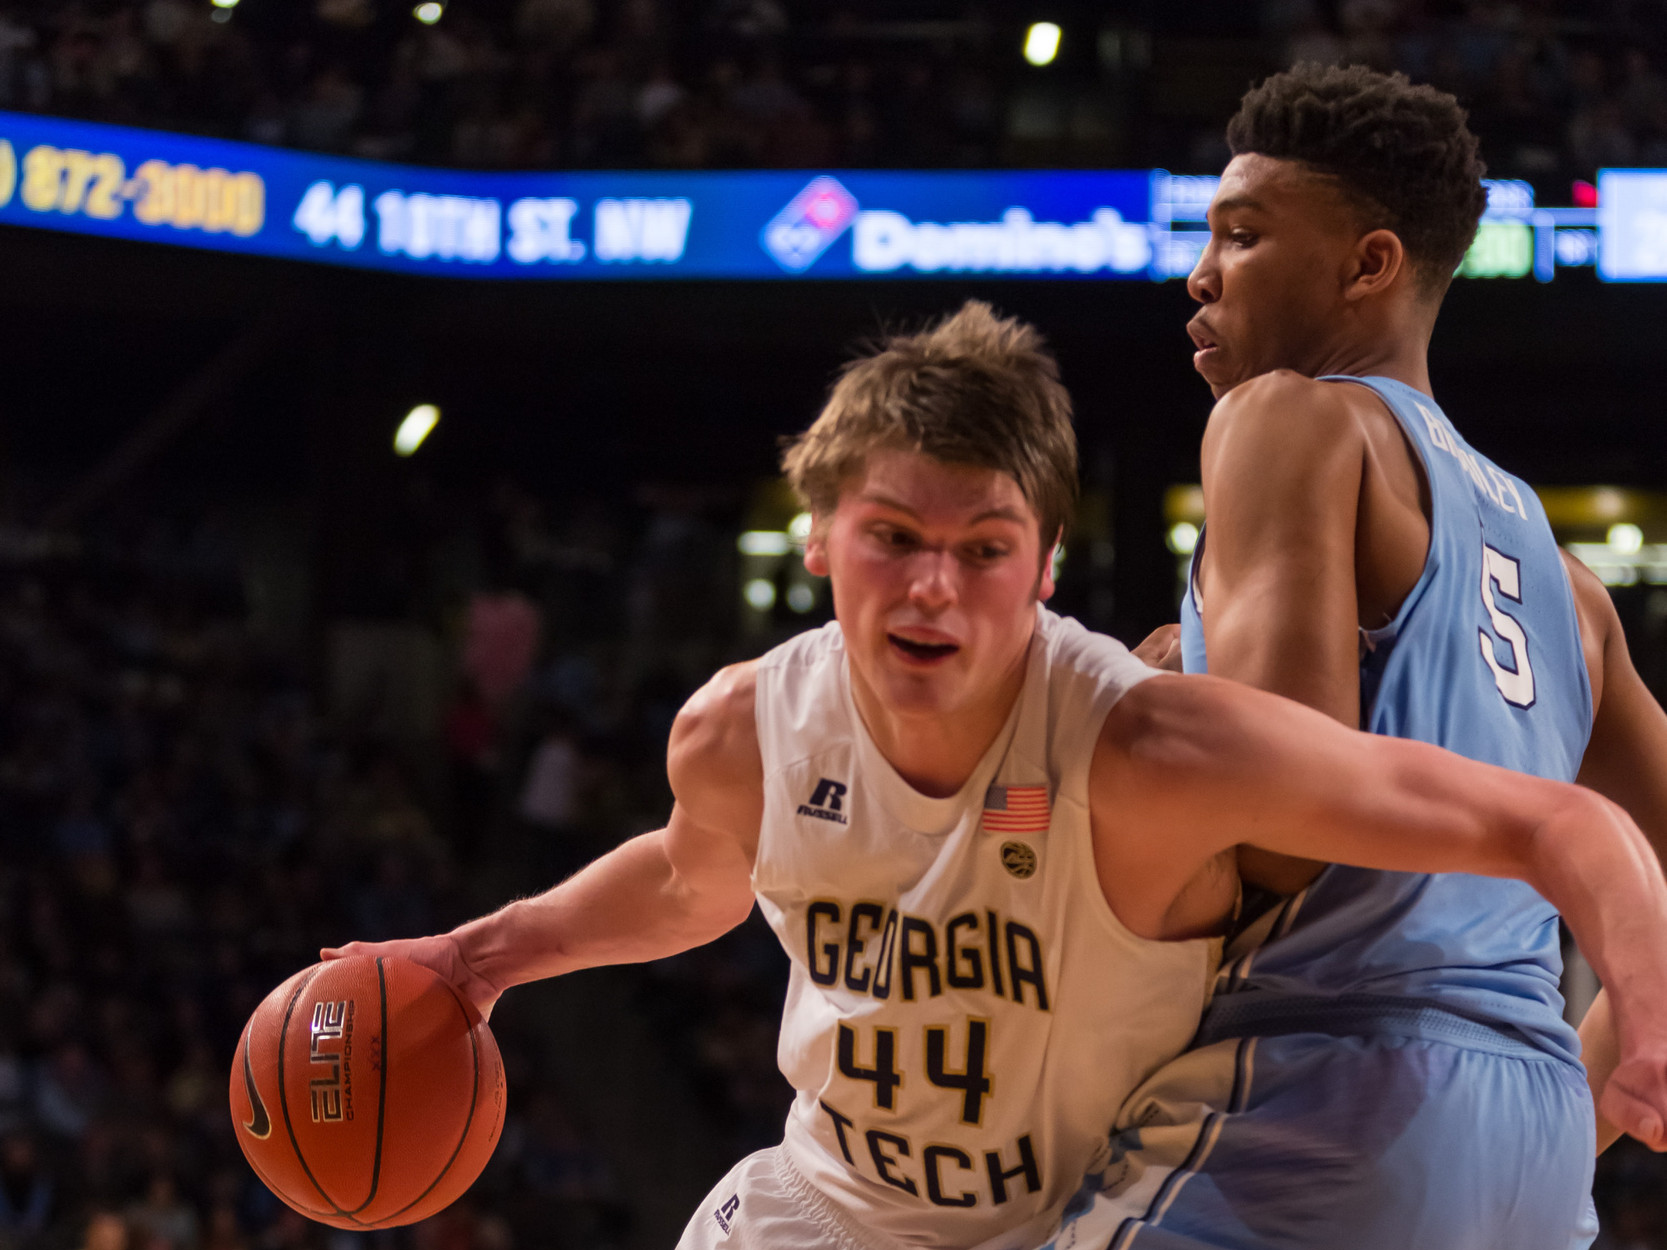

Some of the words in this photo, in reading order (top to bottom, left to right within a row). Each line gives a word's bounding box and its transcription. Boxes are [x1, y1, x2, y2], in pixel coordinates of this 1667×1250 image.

[294, 182, 365, 248] 44
[853, 208, 1152, 271] Domino's
[1477, 542, 1537, 712] 5
[806, 898, 1052, 1012] GEORGIA
[310, 1000, 346, 1123] ELITE
[834, 1015, 995, 1128] 44
[818, 1096, 1044, 1209] TECH
